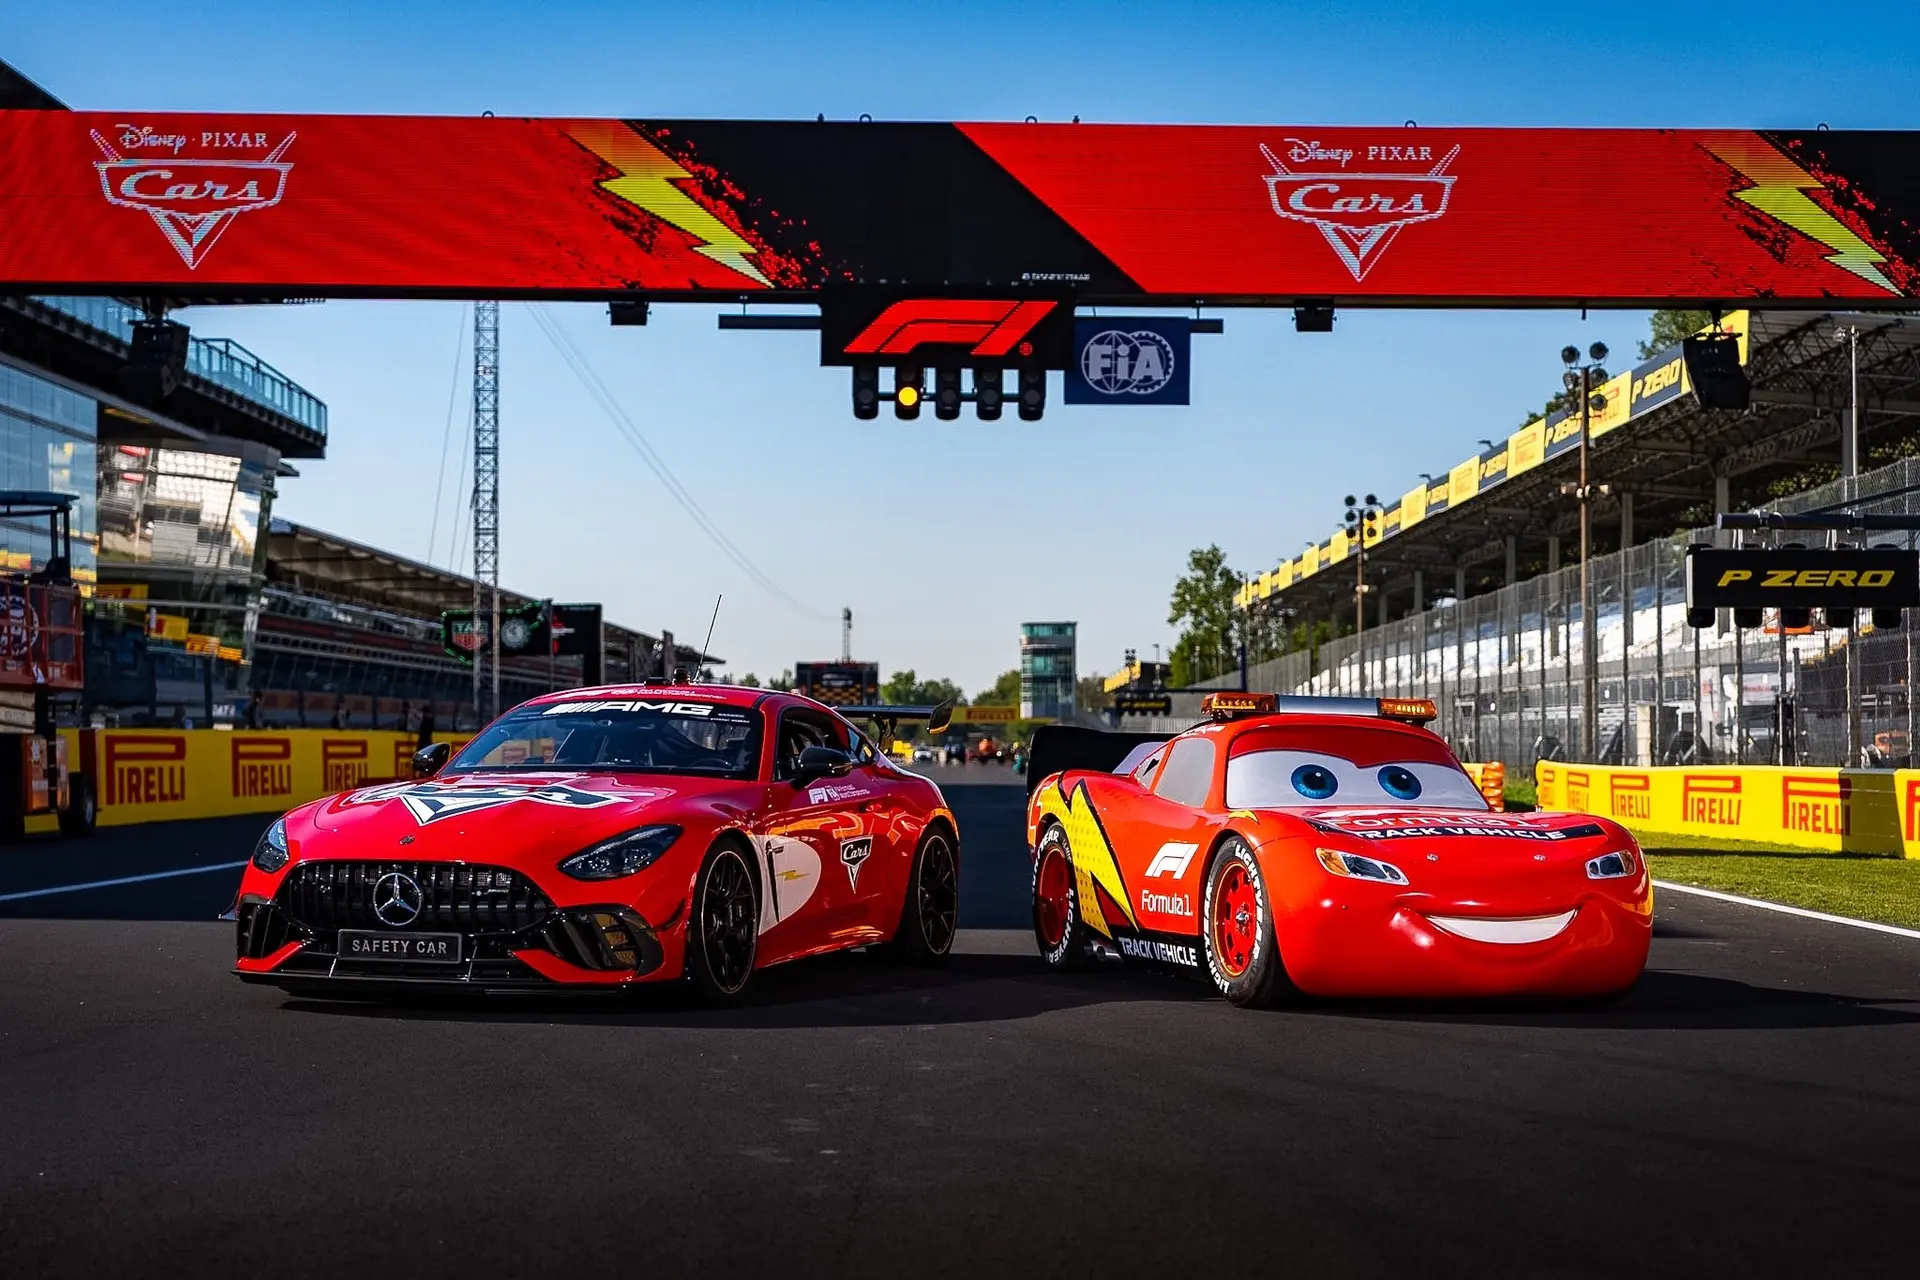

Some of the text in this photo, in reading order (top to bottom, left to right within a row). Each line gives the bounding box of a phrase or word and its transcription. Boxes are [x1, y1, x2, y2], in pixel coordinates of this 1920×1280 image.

[201, 132, 268, 148] PIXAR
[1367, 146, 1433, 161] PIXAR
[120, 169, 265, 200] Cars
[1288, 183, 1429, 213] Cars
[1642, 357, 1682, 399] ZERO
[1717, 569, 1895, 588] P ZERO
[594, 700, 714, 717] AMG
[105, 735, 186, 805] PIRELLI
[231, 737, 292, 798] PIRELLI
[1610, 774, 1650, 820] PIRELLI
[1683, 775, 1742, 826] PIRELLI
[1782, 776, 1852, 827] PIRELLI
[1448, 828, 1566, 840] VEHICLE
[843, 844, 868, 860] Cars
[352, 940, 447, 954] SAFETY CAR
[1118, 936, 1198, 967] TRACK VEHICLE
